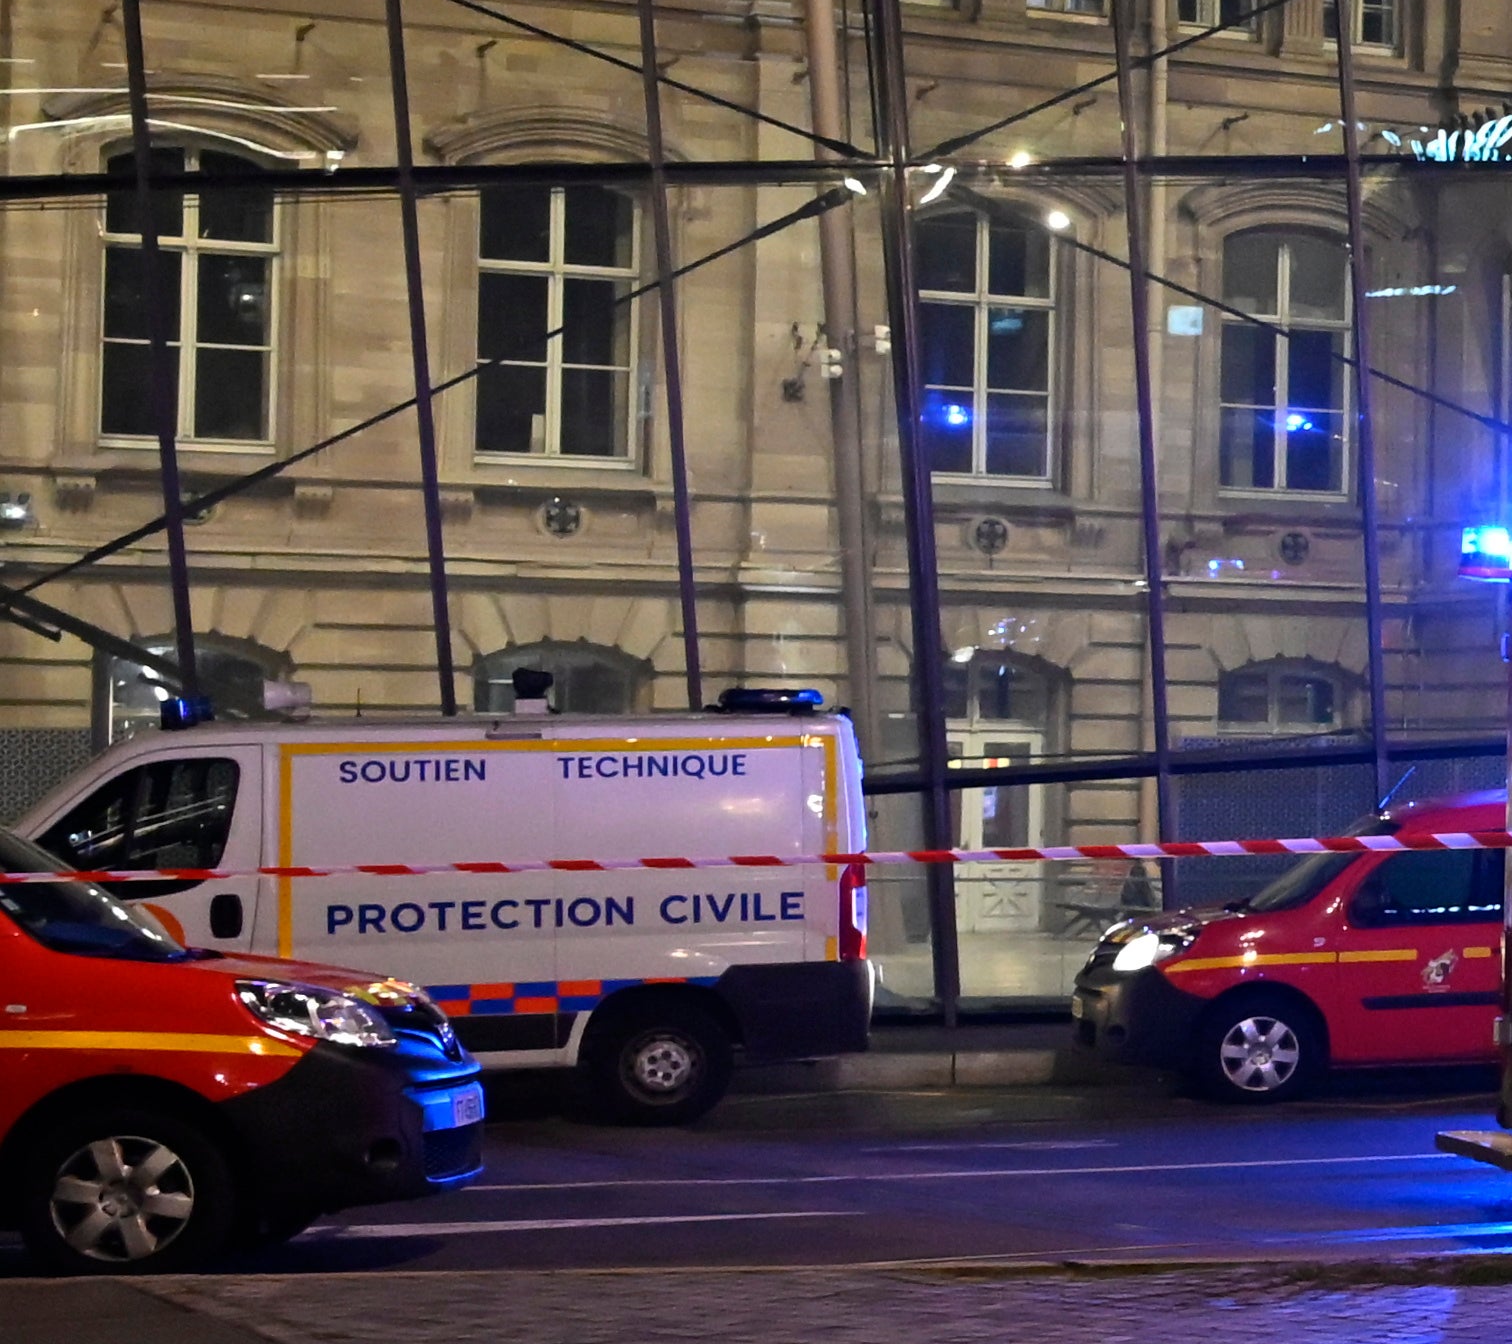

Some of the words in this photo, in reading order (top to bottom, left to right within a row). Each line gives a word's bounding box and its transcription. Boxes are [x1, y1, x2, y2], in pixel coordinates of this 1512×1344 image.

[339, 758, 487, 784] SOUTIEN
[558, 754, 747, 780] TECHNIQUE
[327, 896, 635, 935] PROTECTION
[659, 892, 806, 924] CIVILE
